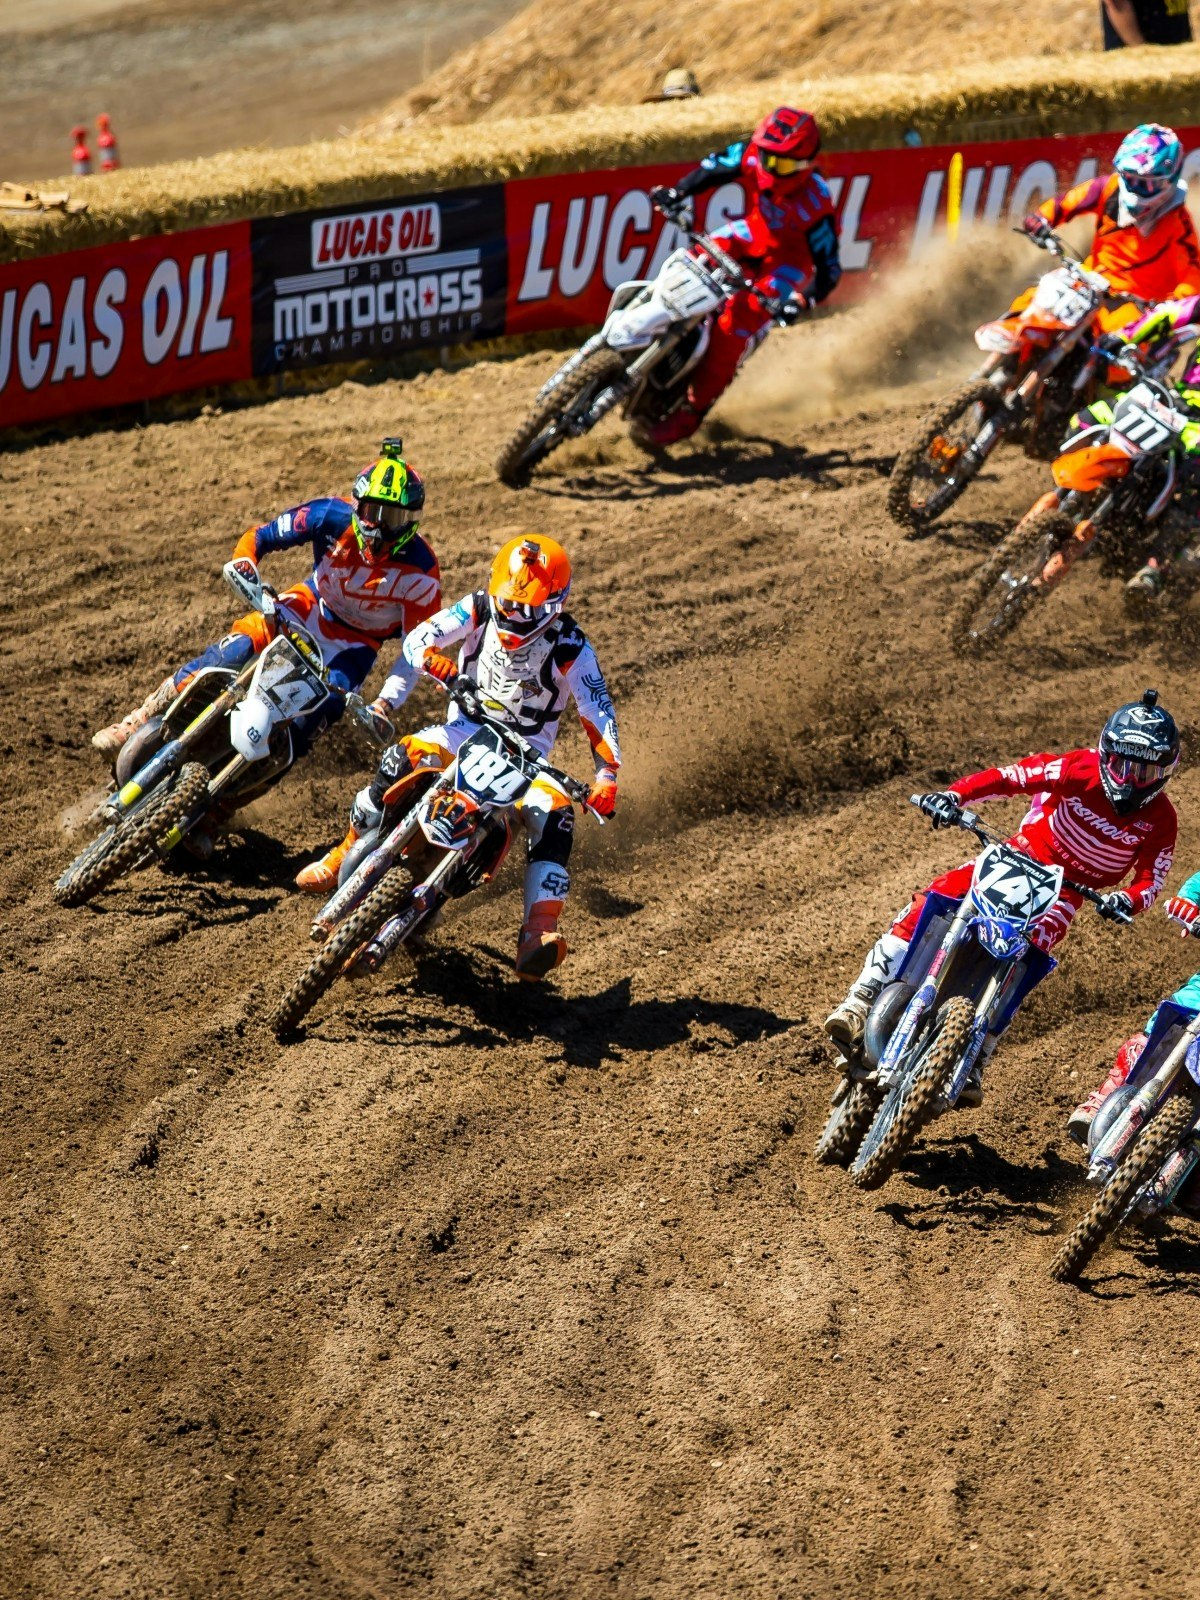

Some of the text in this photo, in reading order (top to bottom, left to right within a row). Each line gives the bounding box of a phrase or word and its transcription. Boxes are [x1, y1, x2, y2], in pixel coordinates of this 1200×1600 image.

[317, 206, 436, 265] LUCAS OIL
[348, 260, 403, 283] PRO
[141, 249, 234, 366] OIL
[274, 268, 484, 342] MOTOCROSS
[274, 312, 484, 362] CHAMPIONSHIP
[257, 653, 313, 718] 14
[459, 744, 527, 801] 184
[1111, 741, 1163, 762] WAGEMAN
[1065, 796, 1144, 846] FASTHOUS
[975, 862, 1056, 919] 141
